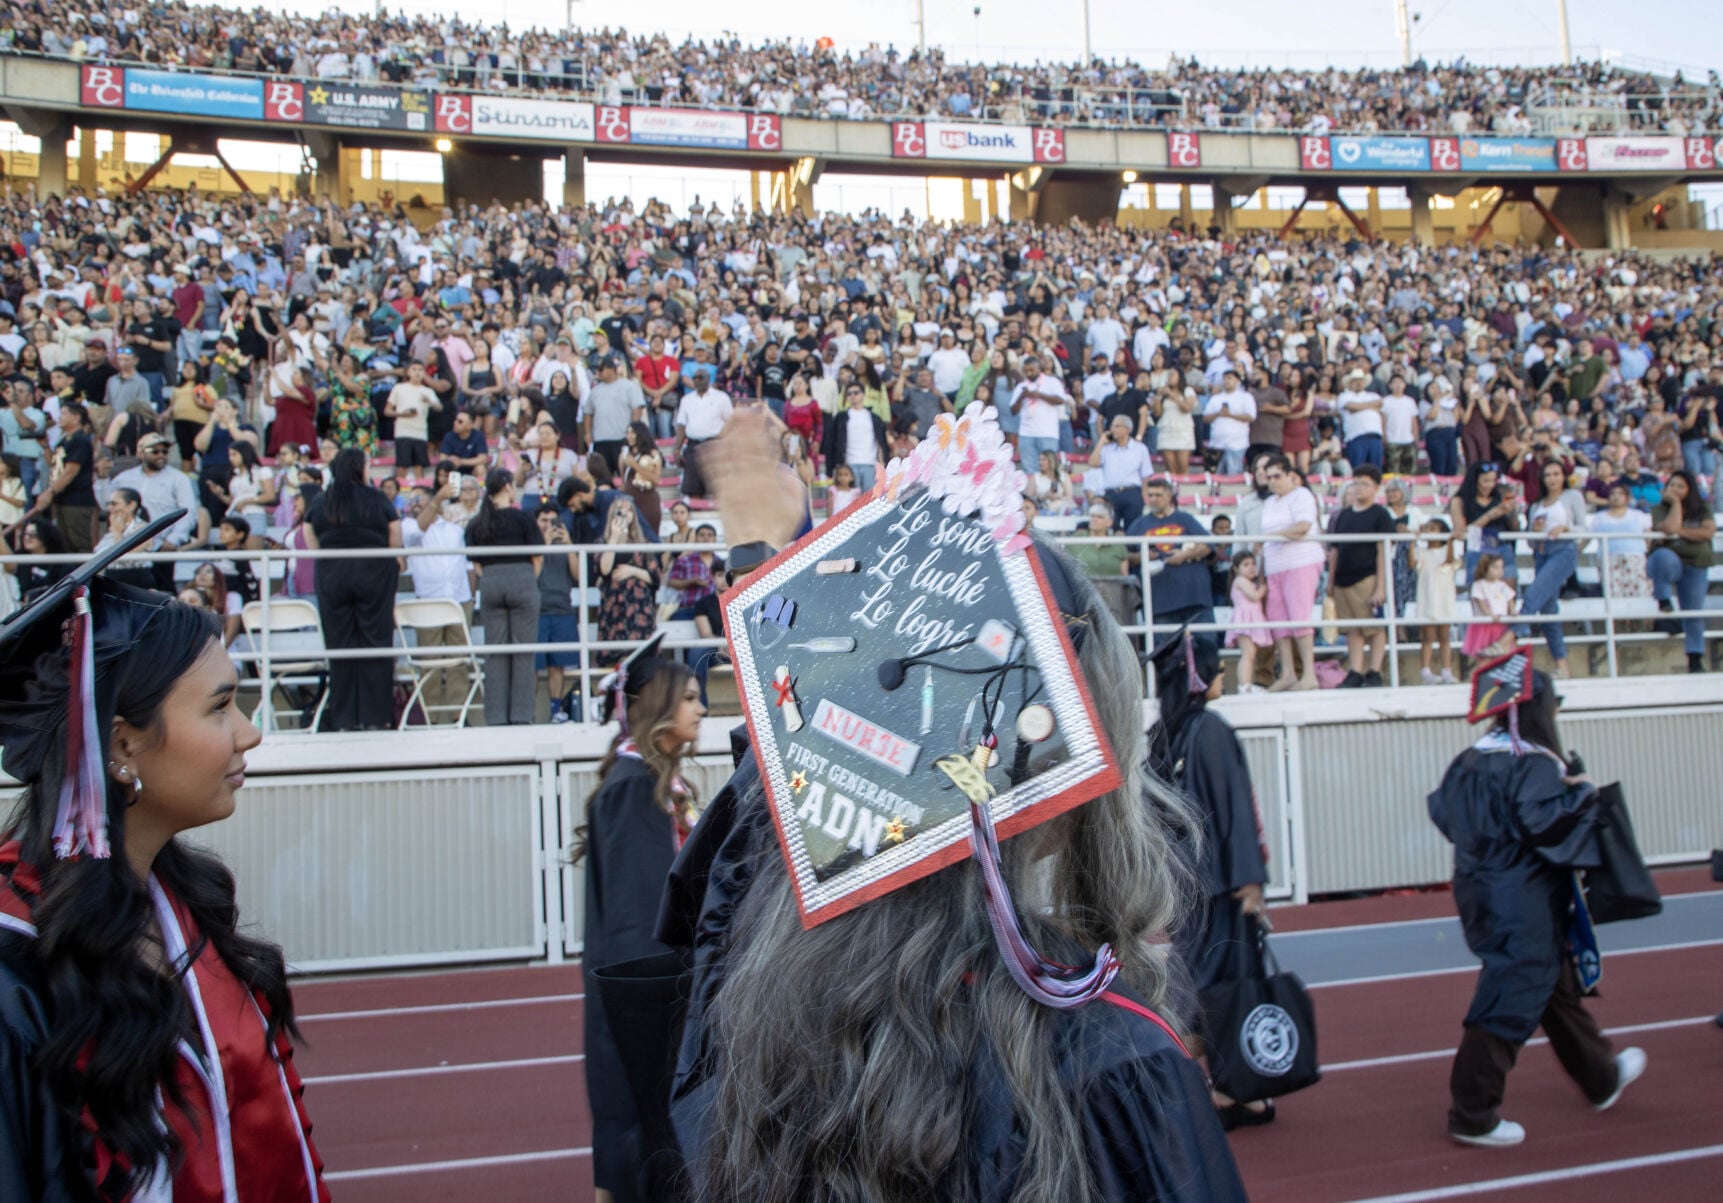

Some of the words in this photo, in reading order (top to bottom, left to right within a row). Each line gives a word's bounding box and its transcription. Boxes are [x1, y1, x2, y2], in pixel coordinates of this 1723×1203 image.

[86, 67, 122, 105] BC
[269, 83, 302, 120] BC
[332, 92, 356, 107] U.S.
[358, 94, 399, 110] ARMY
[438, 96, 469, 132] BC
[599, 108, 628, 141] BC
[752, 116, 779, 149] BC
[896, 124, 924, 157] BC
[1037, 129, 1063, 162] BC
[1172, 133, 1198, 167] BC
[1304, 138, 1329, 169] BC
[1433, 139, 1459, 169] BC
[1561, 139, 1585, 169] BC
[1687, 138, 1713, 168] BC
[887, 492, 933, 537] Lo
[866, 536, 911, 583] Lo
[910, 547, 990, 608] luché
[849, 582, 895, 630] Lo
[894, 595, 975, 658] logré
[821, 705, 908, 766] NURSE
[786, 741, 829, 776] FIRST
[828, 763, 927, 826] GENERATION
[797, 780, 889, 858] ADN
